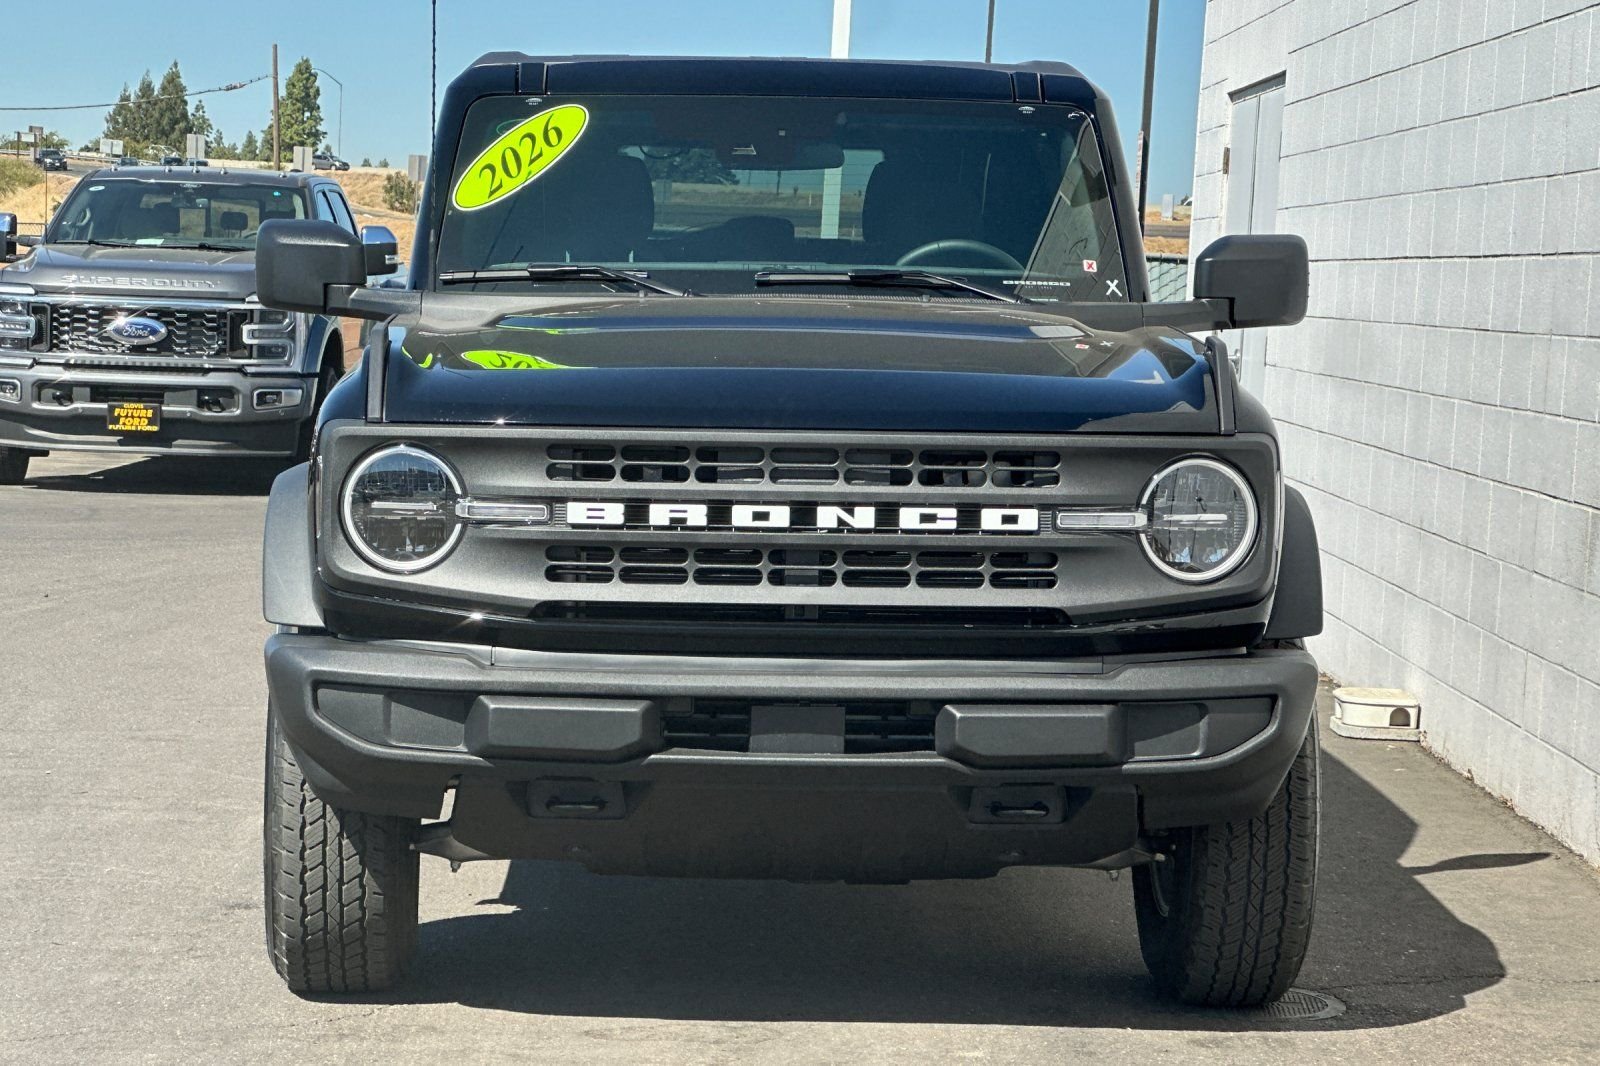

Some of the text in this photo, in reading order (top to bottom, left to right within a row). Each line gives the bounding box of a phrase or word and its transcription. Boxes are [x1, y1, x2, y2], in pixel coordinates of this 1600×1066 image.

[479, 113, 563, 199] 2026
[60, 274, 215, 289] SUPER DUTY
[122, 324, 150, 337] Ford
[114, 408, 153, 417] FUTURE
[119, 417, 148, 425] FORD
[566, 502, 1039, 530] BRONCO
